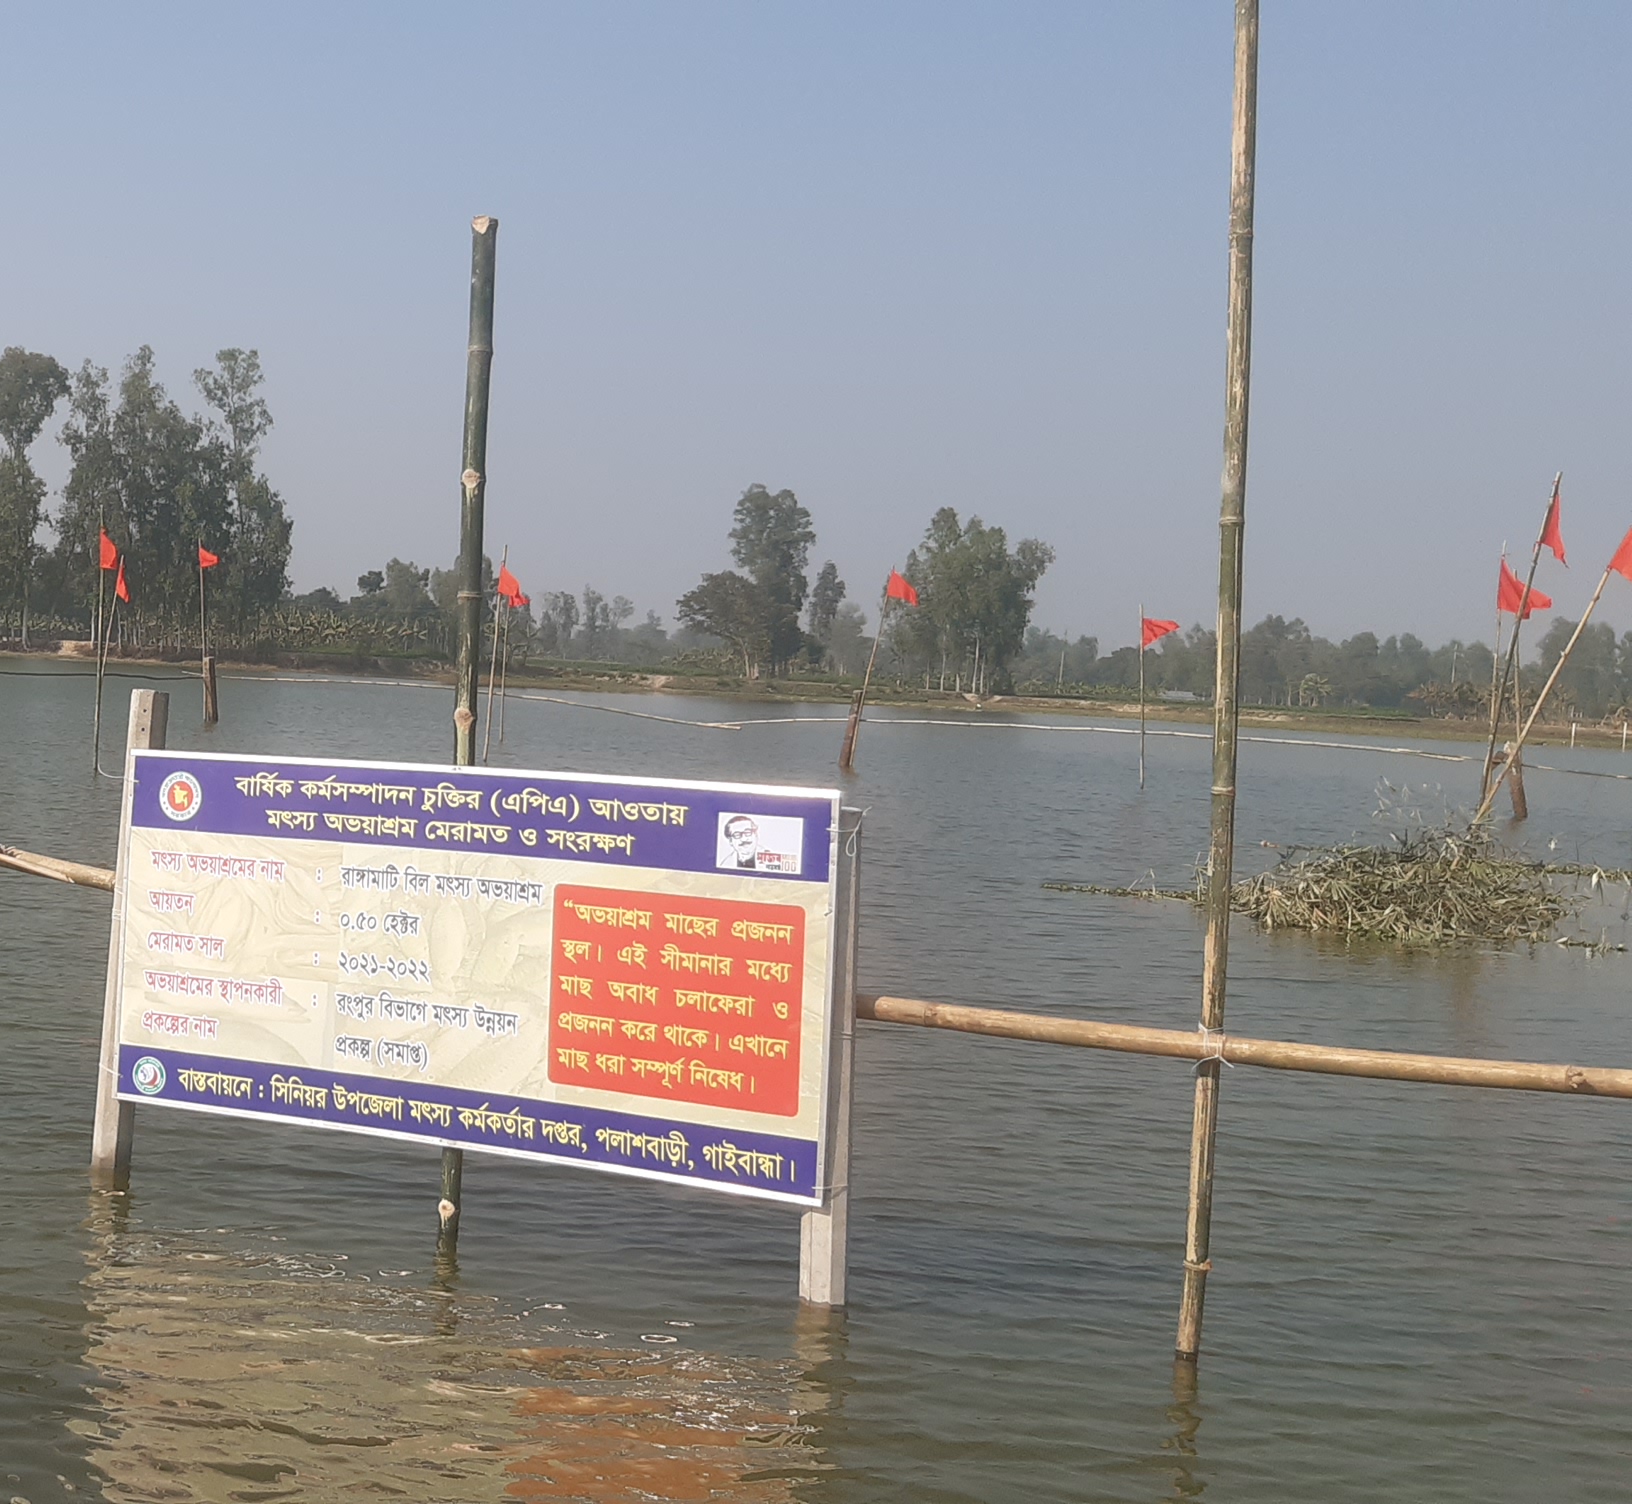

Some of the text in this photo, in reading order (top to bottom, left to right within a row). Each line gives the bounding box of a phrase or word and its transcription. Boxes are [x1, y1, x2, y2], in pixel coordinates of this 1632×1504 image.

[234, 772, 689, 827] বার্ষিক কর্মসম্পাদন চুক্তির (এপিএ) আওতায়
[266, 809, 636, 856] মৎস্য অভয়াশ্রম মেরামত ও সংরক্ষণ
[151, 851, 183, 871] মৎস্য
[187, 854, 256, 878] অভয়াশ্রমের
[260, 859, 285, 880] নাম
[341, 864, 399, 890] রাঙ্গামাটি
[404, 866, 431, 893] বিল
[435, 875, 472, 897] মৎস্য
[476, 878, 543, 903] অভয়াশ্রম
[149, 891, 194, 913] আয়তন
[340, 911, 377, 930] ০.৫০
[383, 910, 419, 935] হেক্টর
[664, 912, 719, 939] মাছের
[731, 919, 794, 945] প্রজনন
[147, 931, 196, 952] মেরামত
[199, 935, 224, 957] সাল
[339, 952, 430, 982] ২০২১-২০২২
[617, 941, 648, 969] এই
[660, 943, 733, 977] সীমানার
[746, 959, 792, 983] মধ্যে
[145, 971, 213, 996] অভয়াশ্রমের
[218, 978, 283, 1005] স্থাপনকারী
[336, 993, 374, 1019] রংপুর
[379, 992, 427, 1022] বিভাগে
[432, 1005, 469, 1028] মৎস্য
[473, 1003, 518, 1035] উন্নয়ন
[559, 974, 789, 1019] মাছ অবাধ চলাফেরা ও
[142, 1012, 428, 1070] প্রকল্পের নাম প্রকল্প (সমাপ্ত)
[558, 1010, 615, 1037] প্রজনন
[620, 1019, 658, 1042] করে
[729, 1034, 789, 1060] এখানে
[556, 1047, 590, 1073] মাছ
[596, 1052, 625, 1076] ধরা
[631, 1057, 685, 1089] সম্পূর্ণ
[178, 1067, 253, 1099] বাস্তবায়নে
[270, 1073, 328, 1110] সিনিয়র
[332, 1081, 404, 1121] উপজেলা
[408, 1099, 452, 1128] মৎস্য
[458, 1102, 535, 1140] কর্মকর্তার
[540, 1118, 588, 1153] দপ্তর,
[595, 1126, 695, 1171] পলাশবাড়ী,
